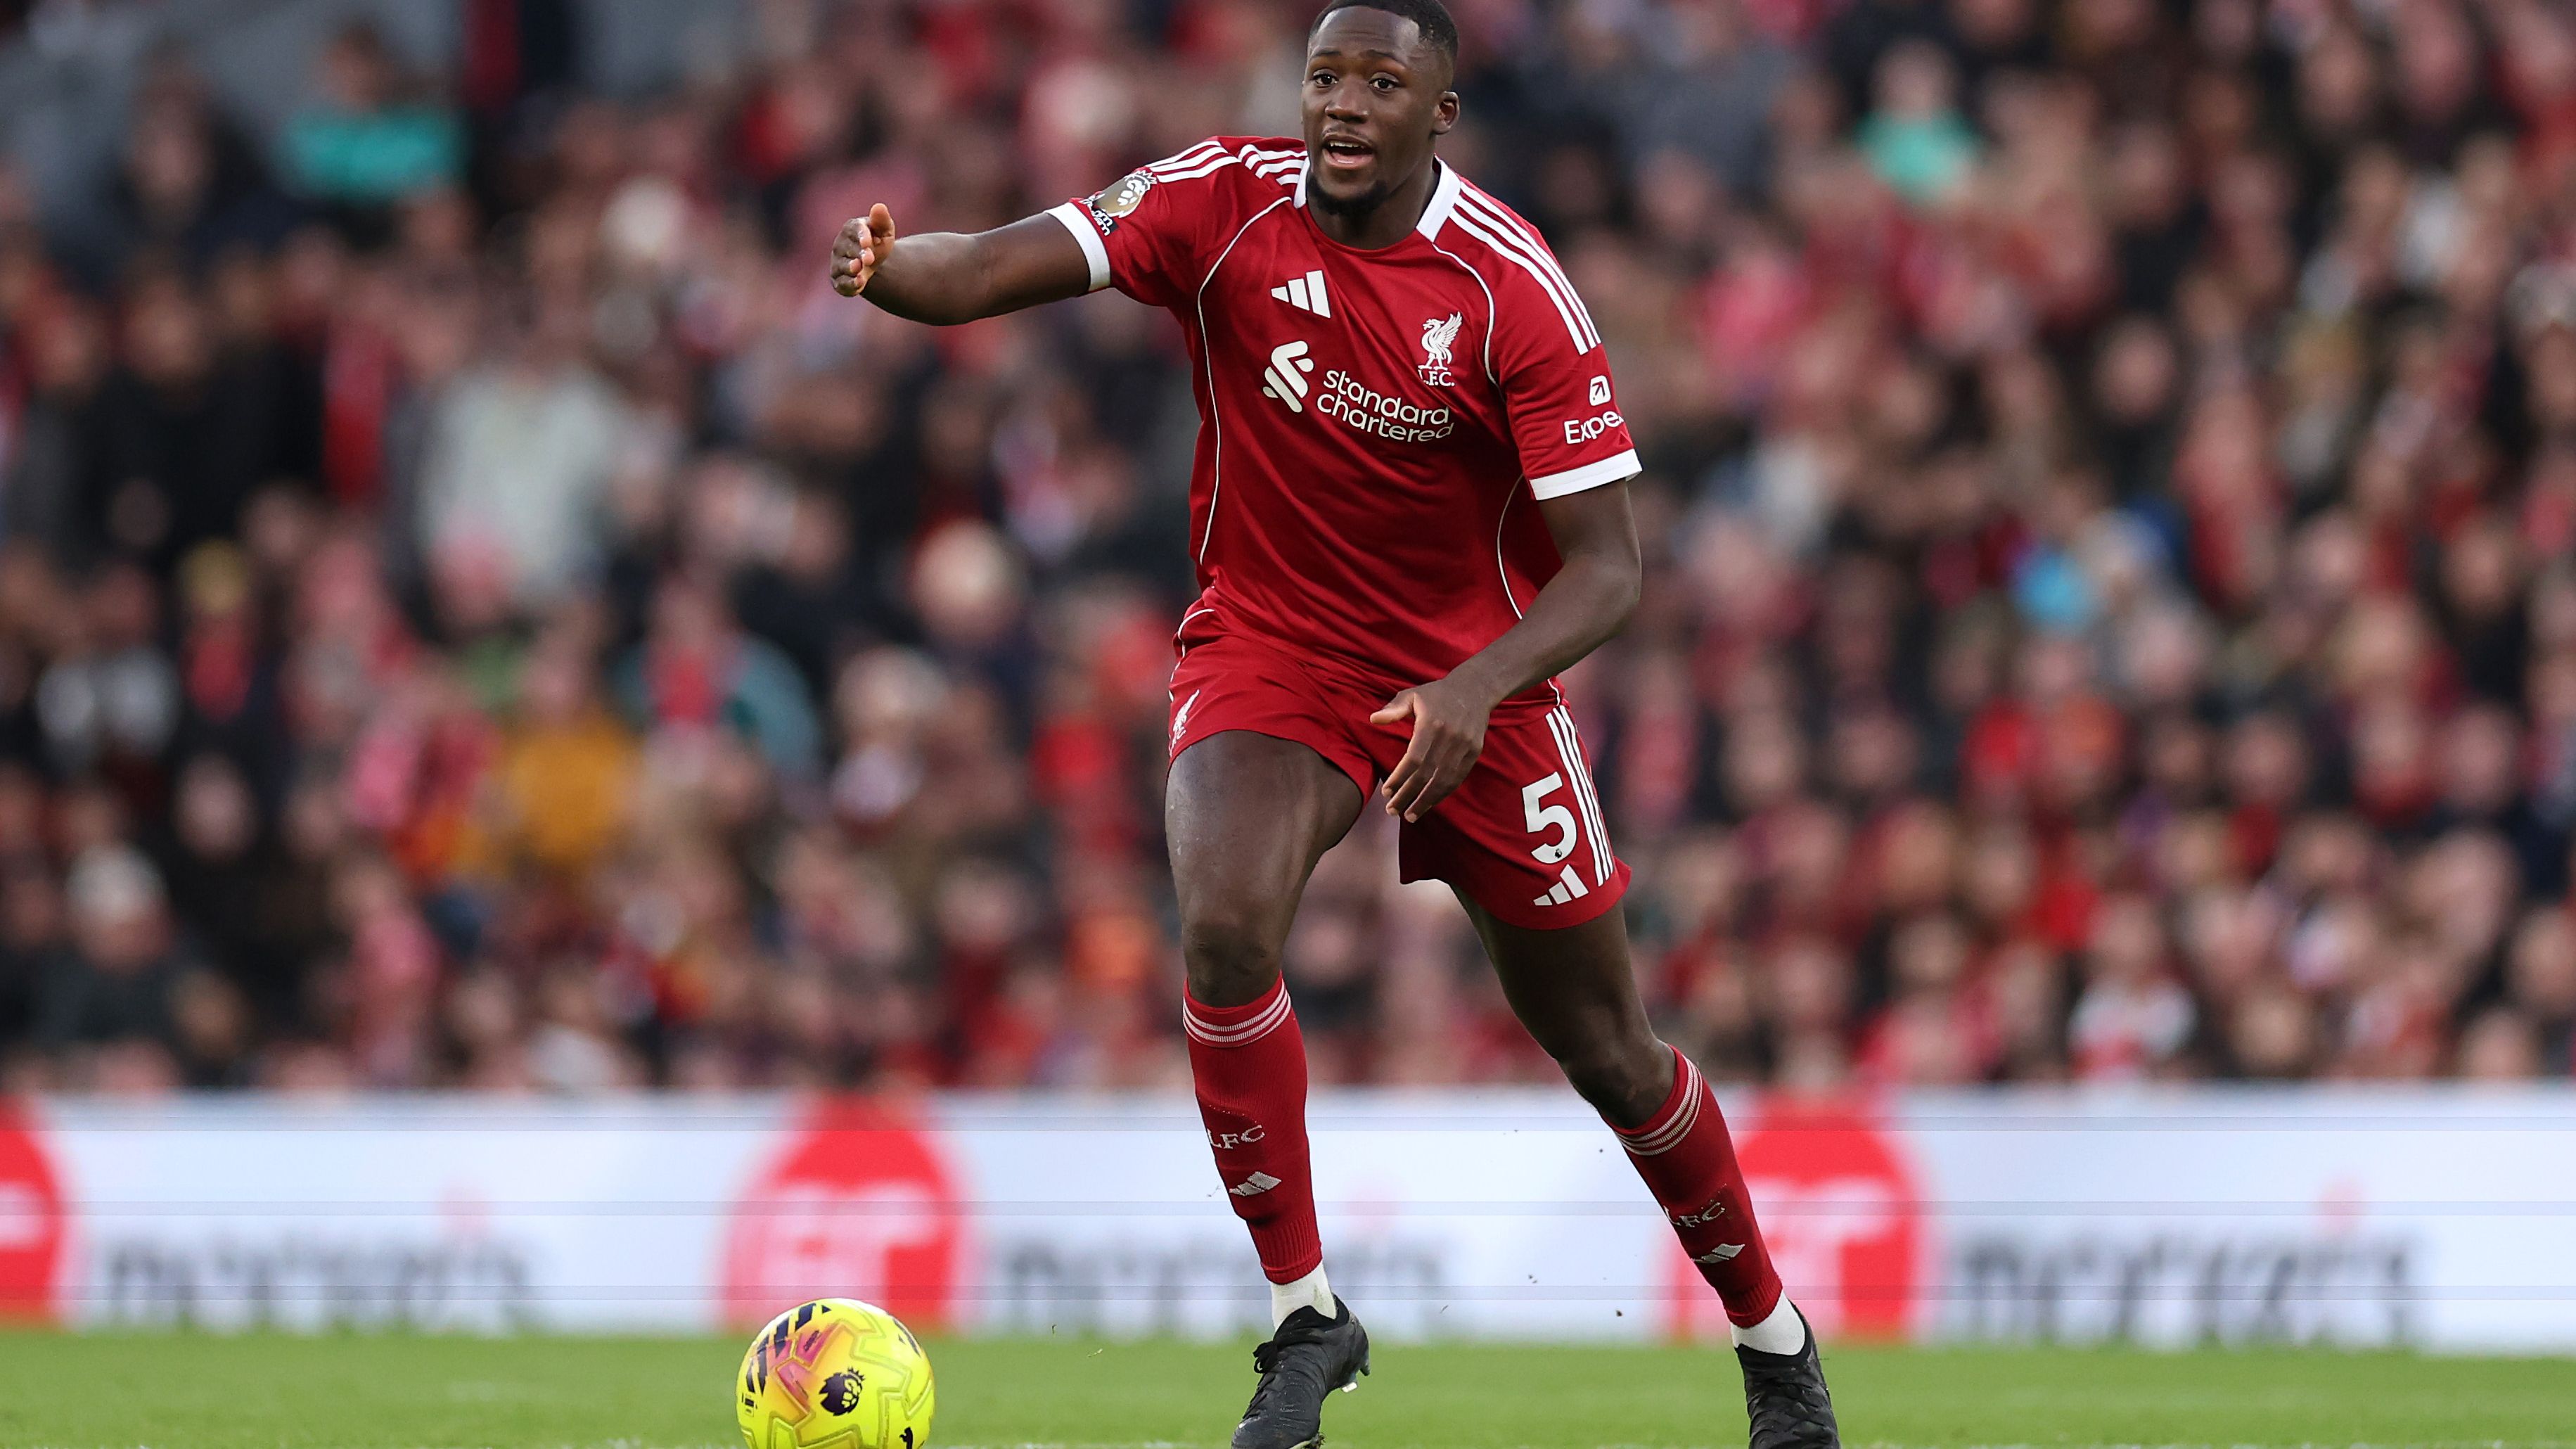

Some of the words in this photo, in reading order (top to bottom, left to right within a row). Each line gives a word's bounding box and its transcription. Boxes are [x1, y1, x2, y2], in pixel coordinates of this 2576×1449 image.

[1317, 394, 1454, 442] chartered
[1324, 370, 1449, 426] standard
[1563, 411, 1624, 445] Expe
[1522, 771, 1577, 864] 5
[1207, 1125, 1265, 1149] LFC
